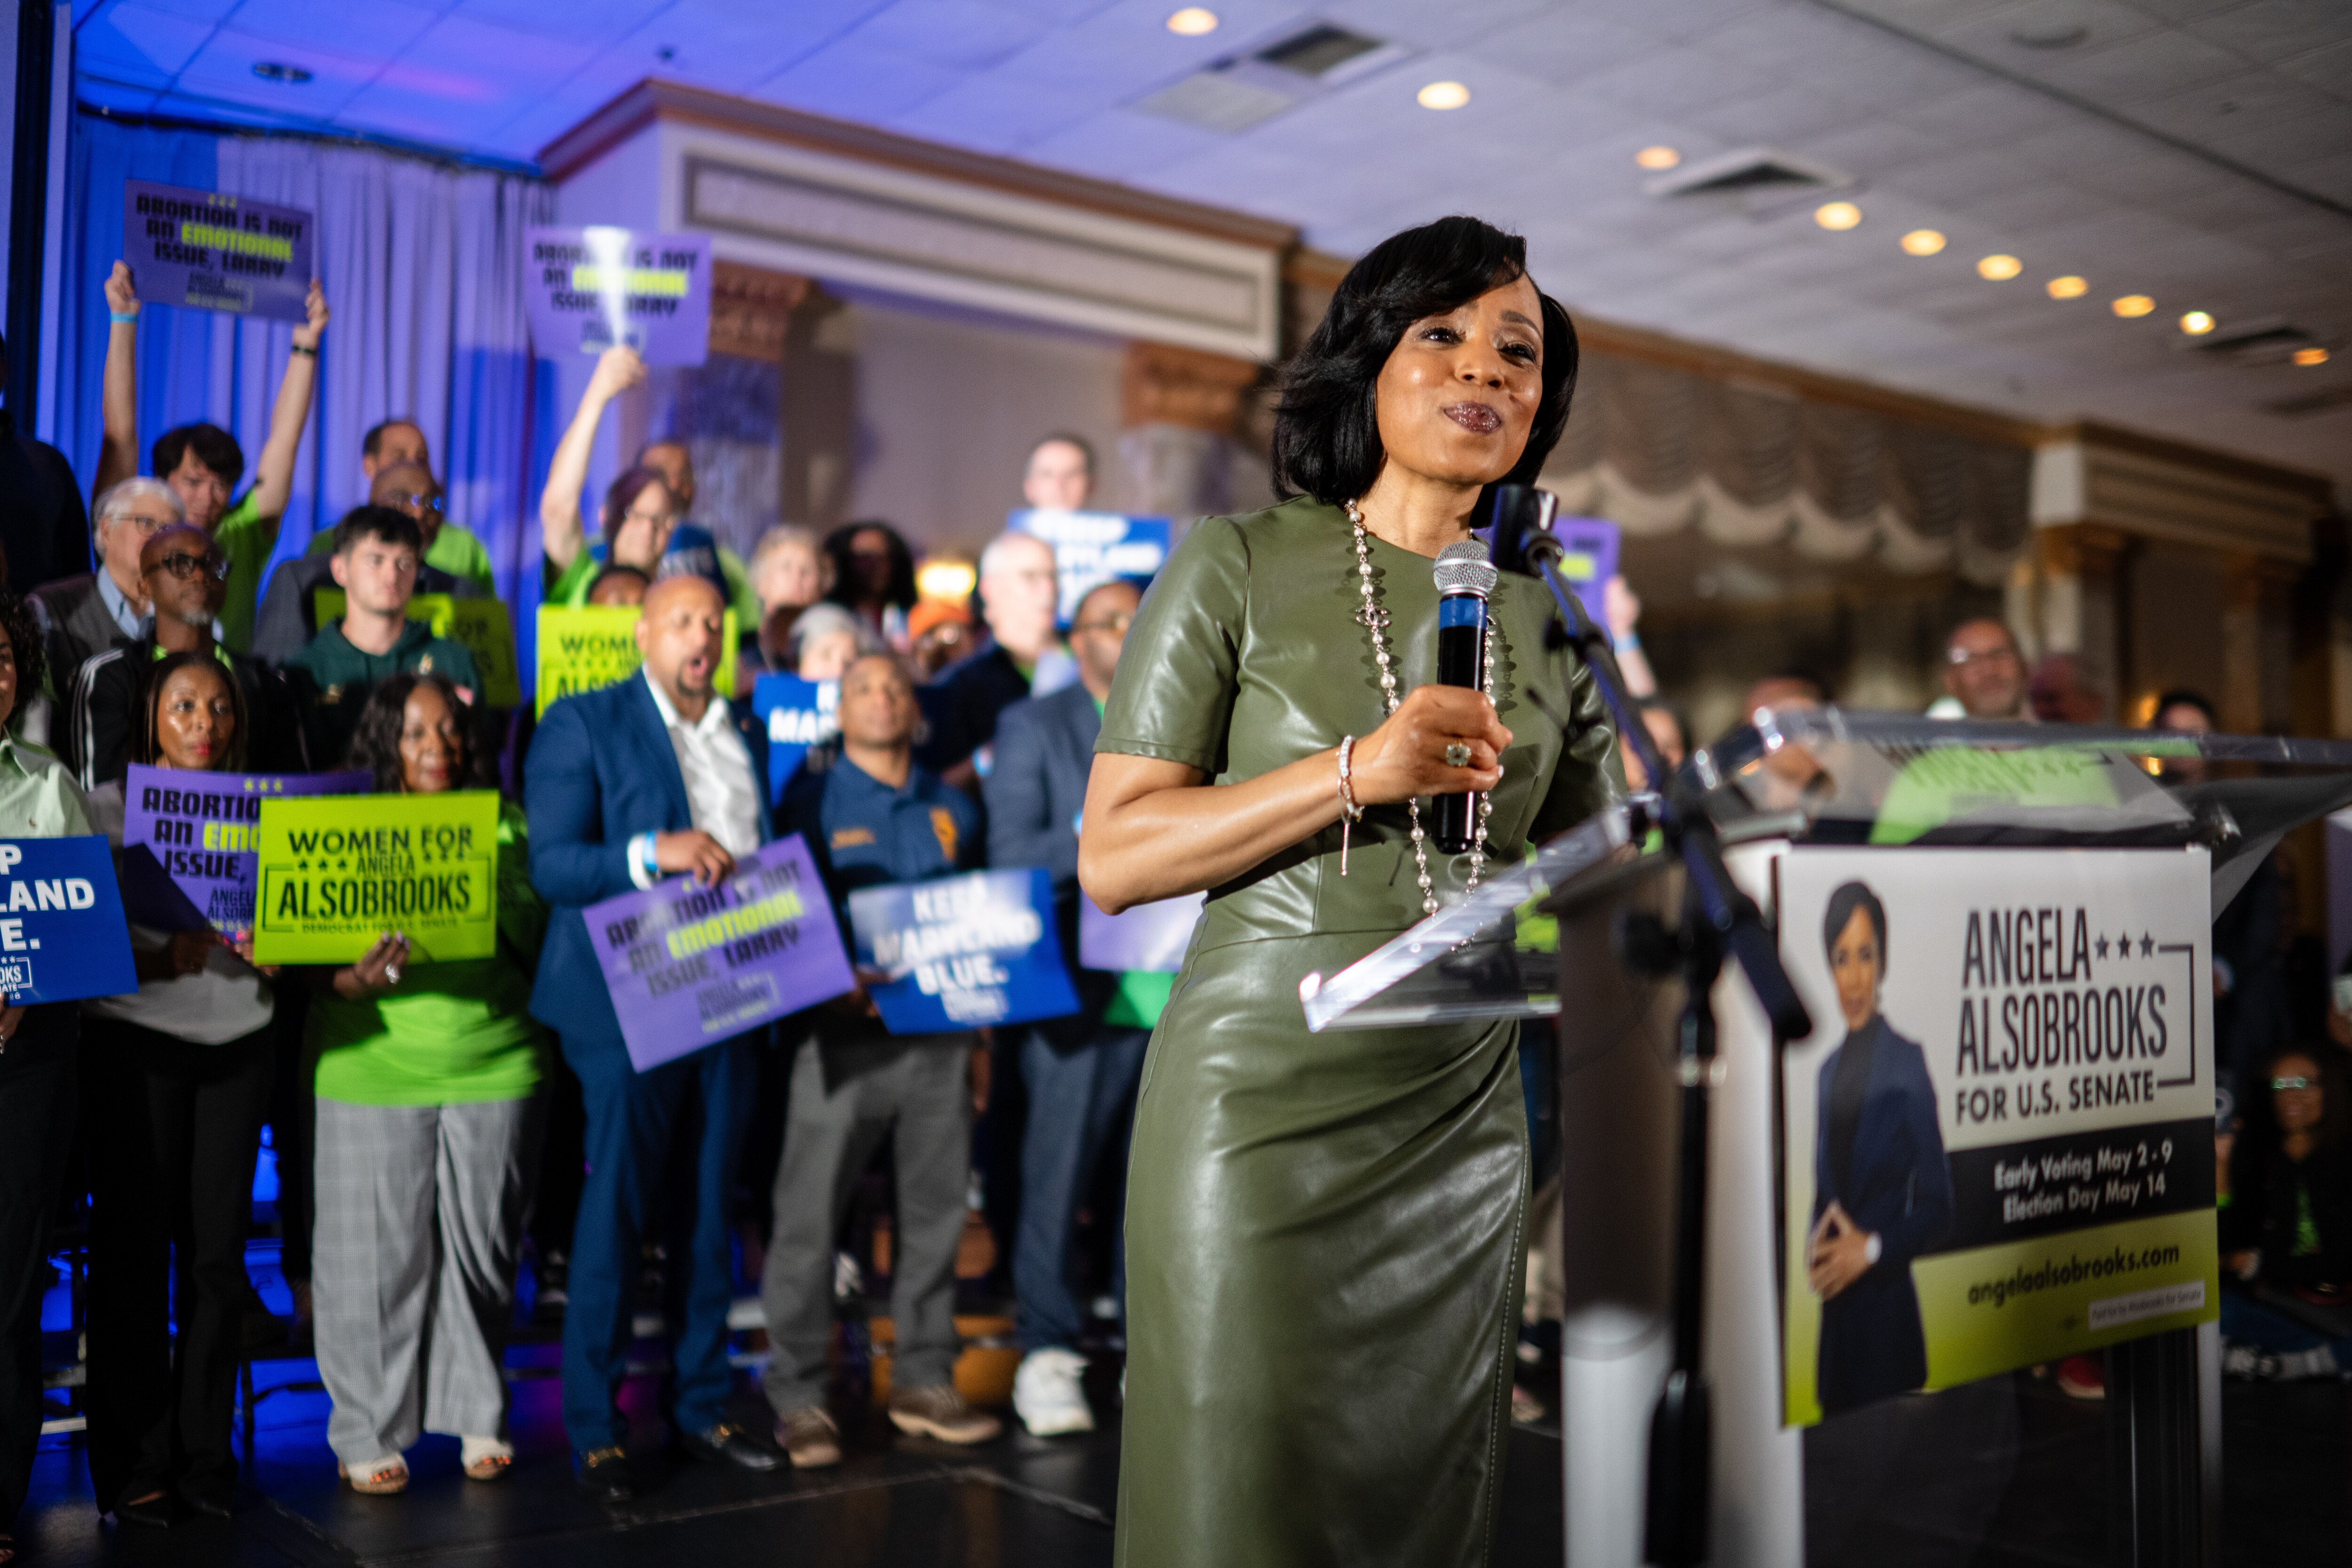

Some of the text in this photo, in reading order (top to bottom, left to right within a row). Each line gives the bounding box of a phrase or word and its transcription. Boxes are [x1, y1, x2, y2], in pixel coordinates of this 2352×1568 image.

[154, 820, 193, 846] AN
[287, 823, 472, 854] WOMEN FOR
[357, 852, 416, 877] ANGELA
[278, 874, 470, 920] ALSOBROOKS
[1962, 907, 2092, 988] ANGELA
[1956, 984, 2167, 1078] ALSOBROOKS
[1956, 1069, 2154, 1126] FOR U.S. SENATE
[1994, 1157, 2039, 1191] Early
[2041, 1151, 2093, 1181] Voting
[2097, 1146, 2132, 1175] May
[2137, 1140, 2147, 1168] 2
[2161, 1137, 2173, 1165] 9
[2003, 1172, 2165, 1223] Election Day May 14
[1968, 1245, 2179, 1308] angelaalsobrooks.com
